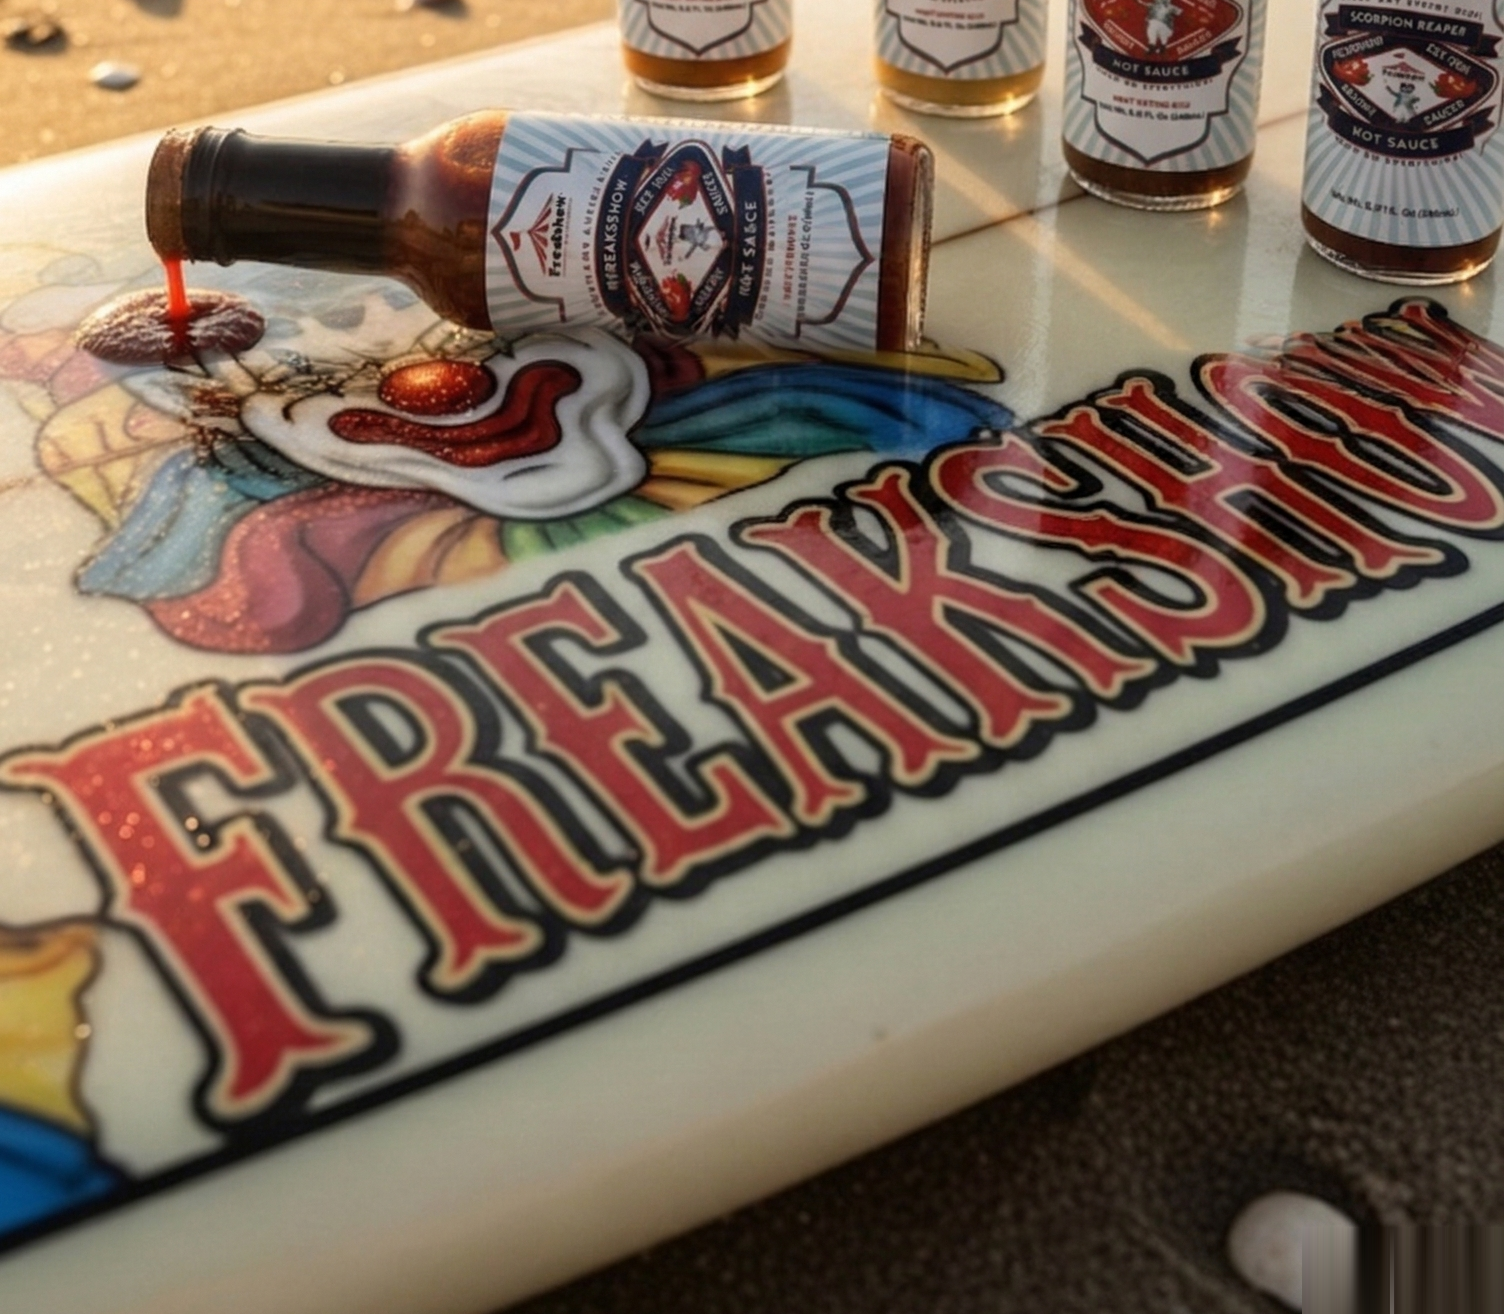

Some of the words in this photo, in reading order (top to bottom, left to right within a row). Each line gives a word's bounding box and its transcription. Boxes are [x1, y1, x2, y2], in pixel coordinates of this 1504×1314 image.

[1350, 10, 1414, 29] SCORPION
[1416, 20, 1468, 38] REAPER
[1144, 66, 1190, 77] SAUCE
[1387, 136, 1439, 151] SAUCE
[0, 296, 1504, 1124] FREAKSHOW
